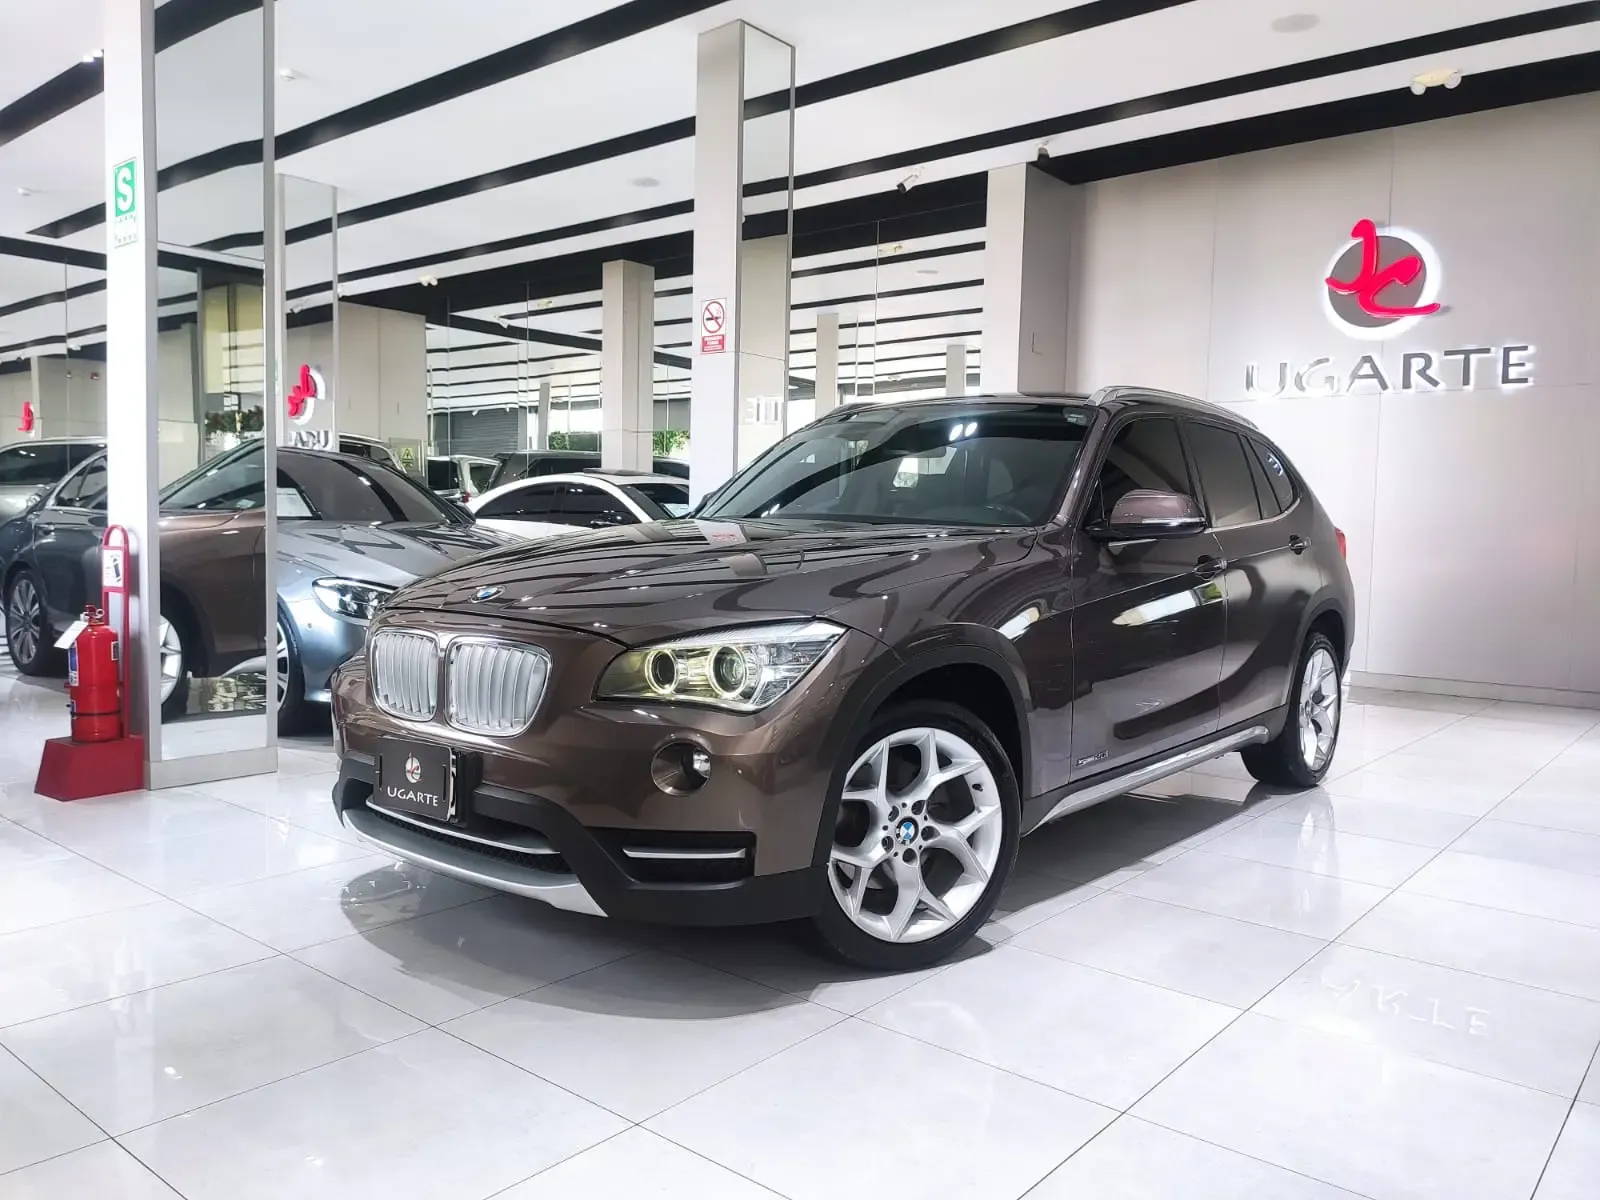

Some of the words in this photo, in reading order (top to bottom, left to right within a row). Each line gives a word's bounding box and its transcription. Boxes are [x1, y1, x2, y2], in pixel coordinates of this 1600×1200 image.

[117, 166, 134, 212] S
[1245, 345, 1530, 396] UGARTE
[387, 785, 439, 807] UGARTE
